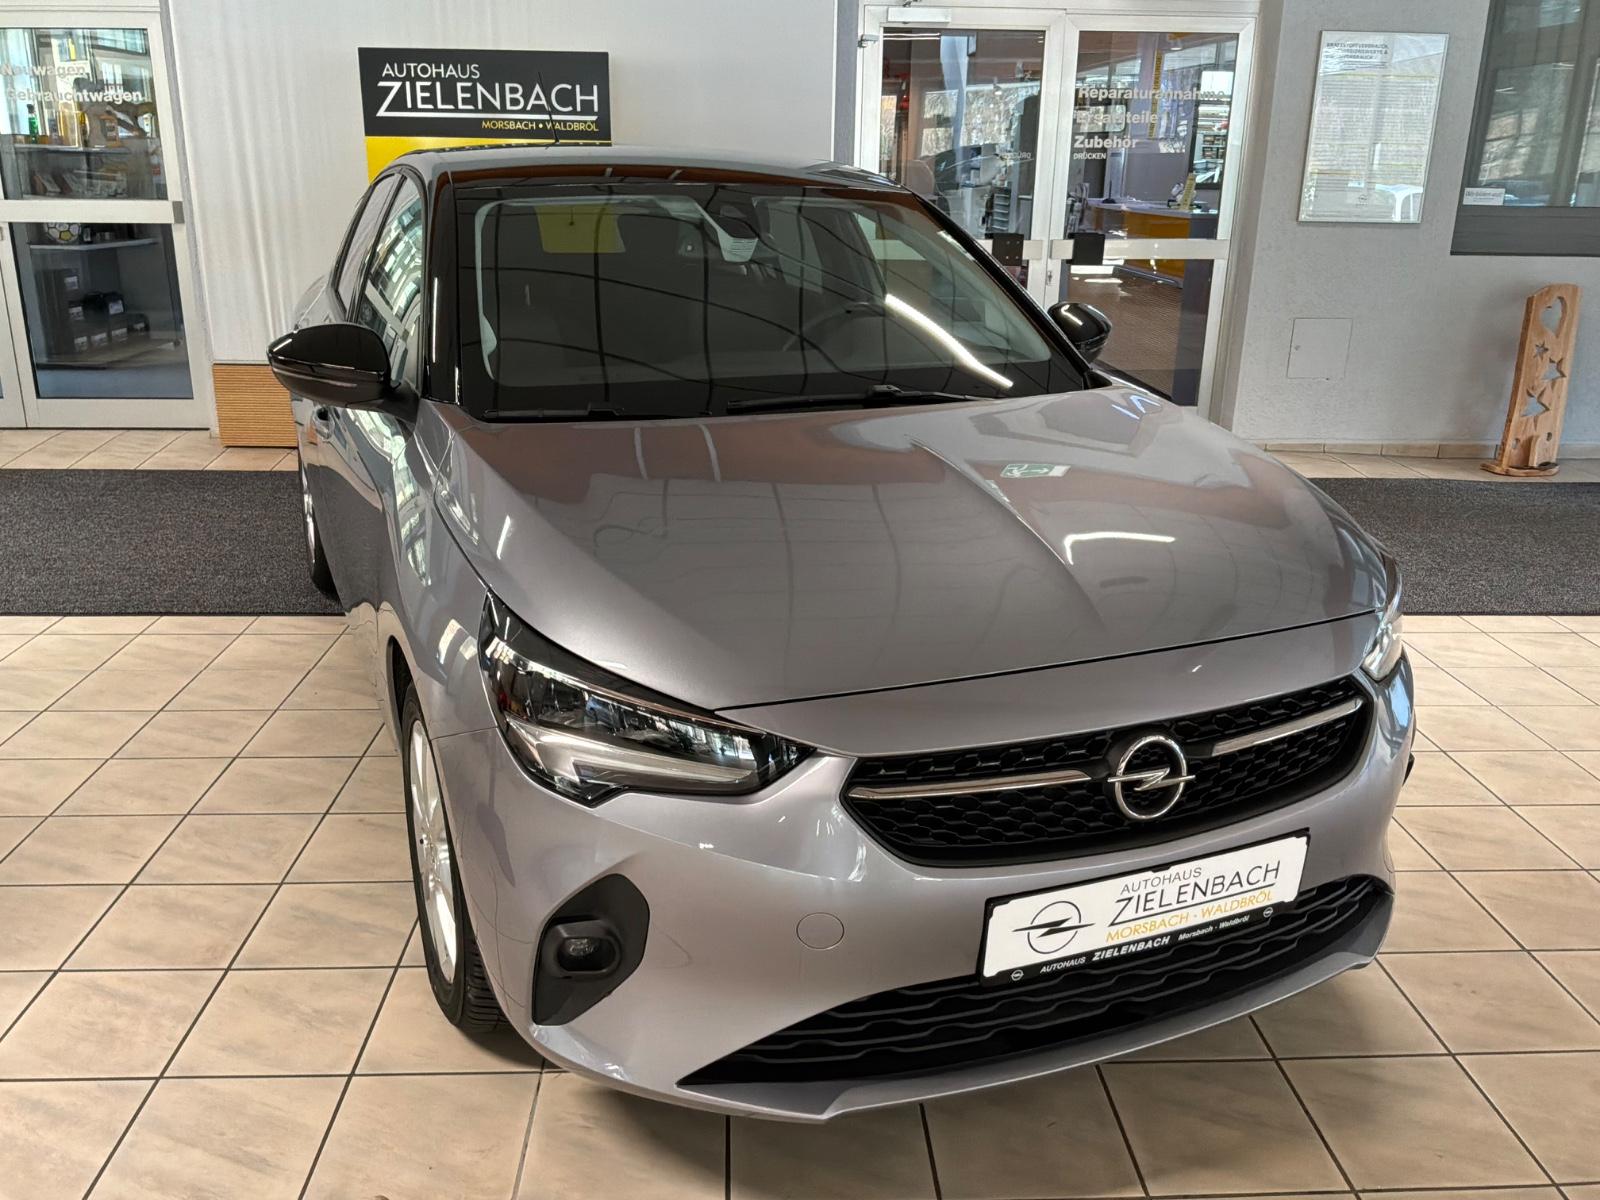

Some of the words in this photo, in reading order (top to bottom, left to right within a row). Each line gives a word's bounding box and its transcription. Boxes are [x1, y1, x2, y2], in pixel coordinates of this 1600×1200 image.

[381, 63, 480, 79] AUTOHAUS
[376, 81, 599, 120] ZIELENBACH
[481, 120, 536, 131] MORSBACH
[546, 121, 599, 132] WALDBRÖL
[1073, 135, 1138, 148] Zubehör
[1073, 151, 1107, 160] DRÜCKEN
[1108, 860, 1281, 927] ZIELENBACH
[1120, 867, 1202, 895] AUTOHAUS
[1105, 911, 1190, 943] MORSBACH
[1201, 890, 1274, 920] WALDBRÖL
[1040, 956, 1086, 974] AUTOHAUS
[1092, 935, 1170, 962] ZIELENBACH
[1178, 926, 1213, 941] Morsbach
[1219, 914, 1250, 930] Waldbröl
